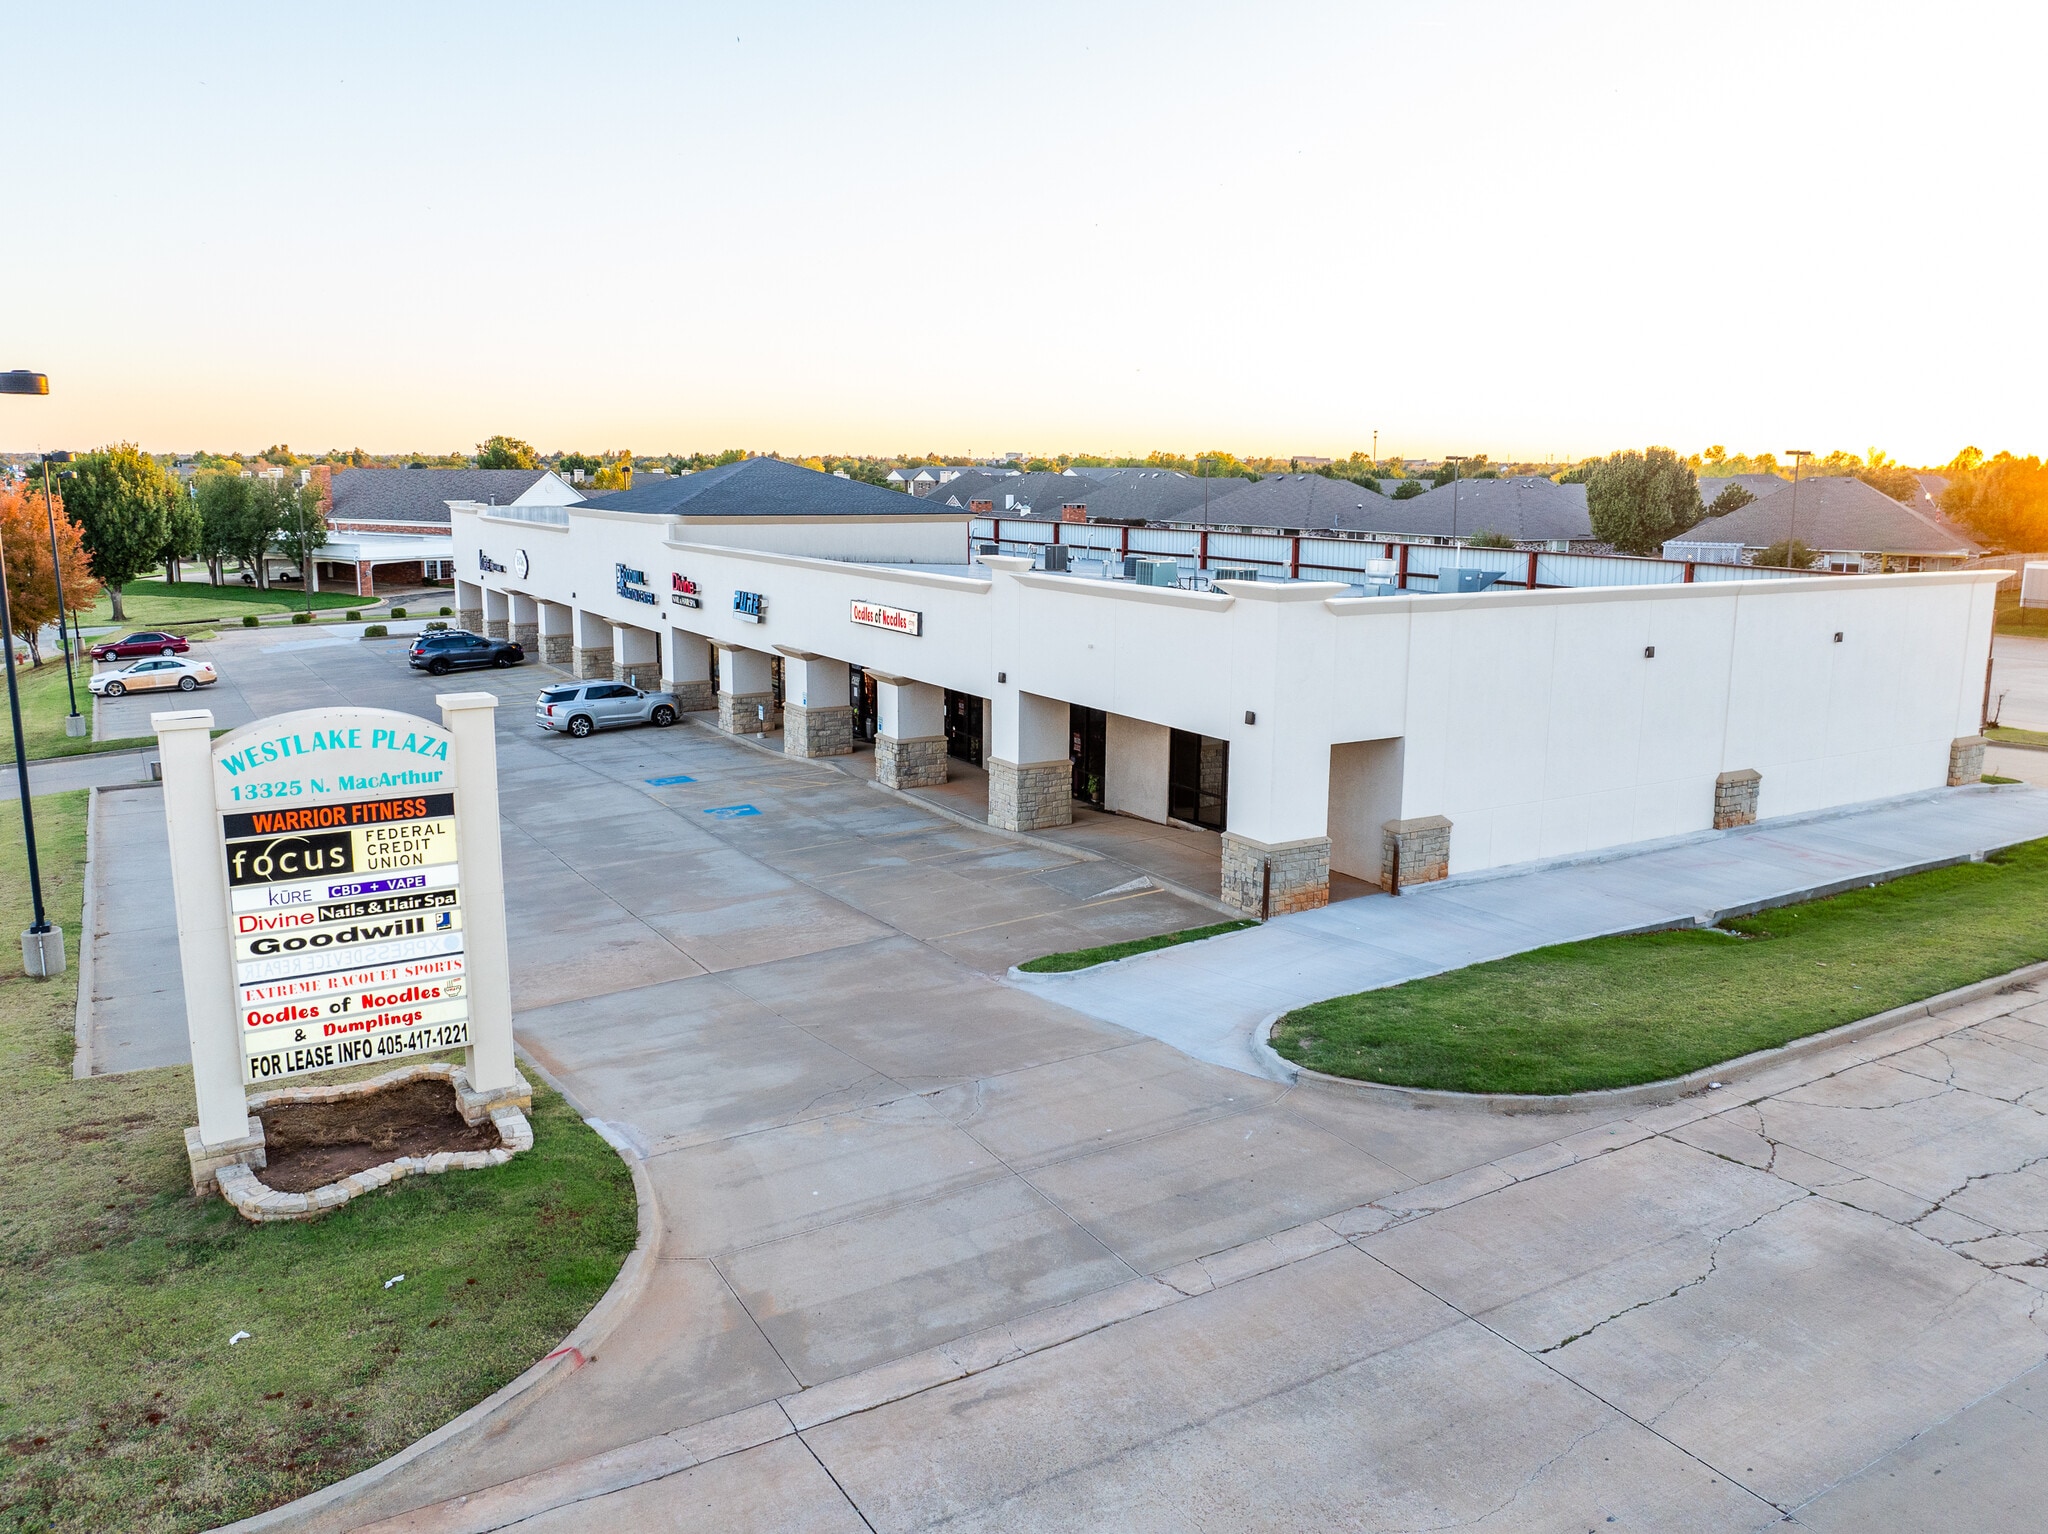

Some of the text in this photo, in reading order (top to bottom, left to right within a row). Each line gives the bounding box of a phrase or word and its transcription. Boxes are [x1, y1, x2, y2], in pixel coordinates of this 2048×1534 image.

[672, 572, 695, 594] Divine
[853, 605, 907, 629] Oodles of Noodles
[221, 728, 449, 776] WESTLAKE PLAZA
[231, 770, 444, 800] 13325 N. MacArthur
[252, 798, 427, 834] WARRIOR FITNESS
[365, 823, 445, 842] FEDERAL
[232, 841, 345, 880] focus
[367, 838, 431, 856] CREDIT
[367, 853, 423, 870] UNION
[331, 884, 361, 898] CBD
[386, 875, 424, 890] VAPE
[239, 893, 455, 933] Divine Nails & Hair Spa
[250, 917, 424, 955] Goodwill
[246, 959, 462, 1001] EXTREME RACQUET SPORTS
[247, 1005, 319, 1027] Oodles
[329, 996, 352, 1014] of
[361, 986, 441, 1009] Noodles
[294, 1010, 422, 1042] & Dumplings
[250, 1023, 469, 1078] FOR LEASE INFO 405-417-1221
